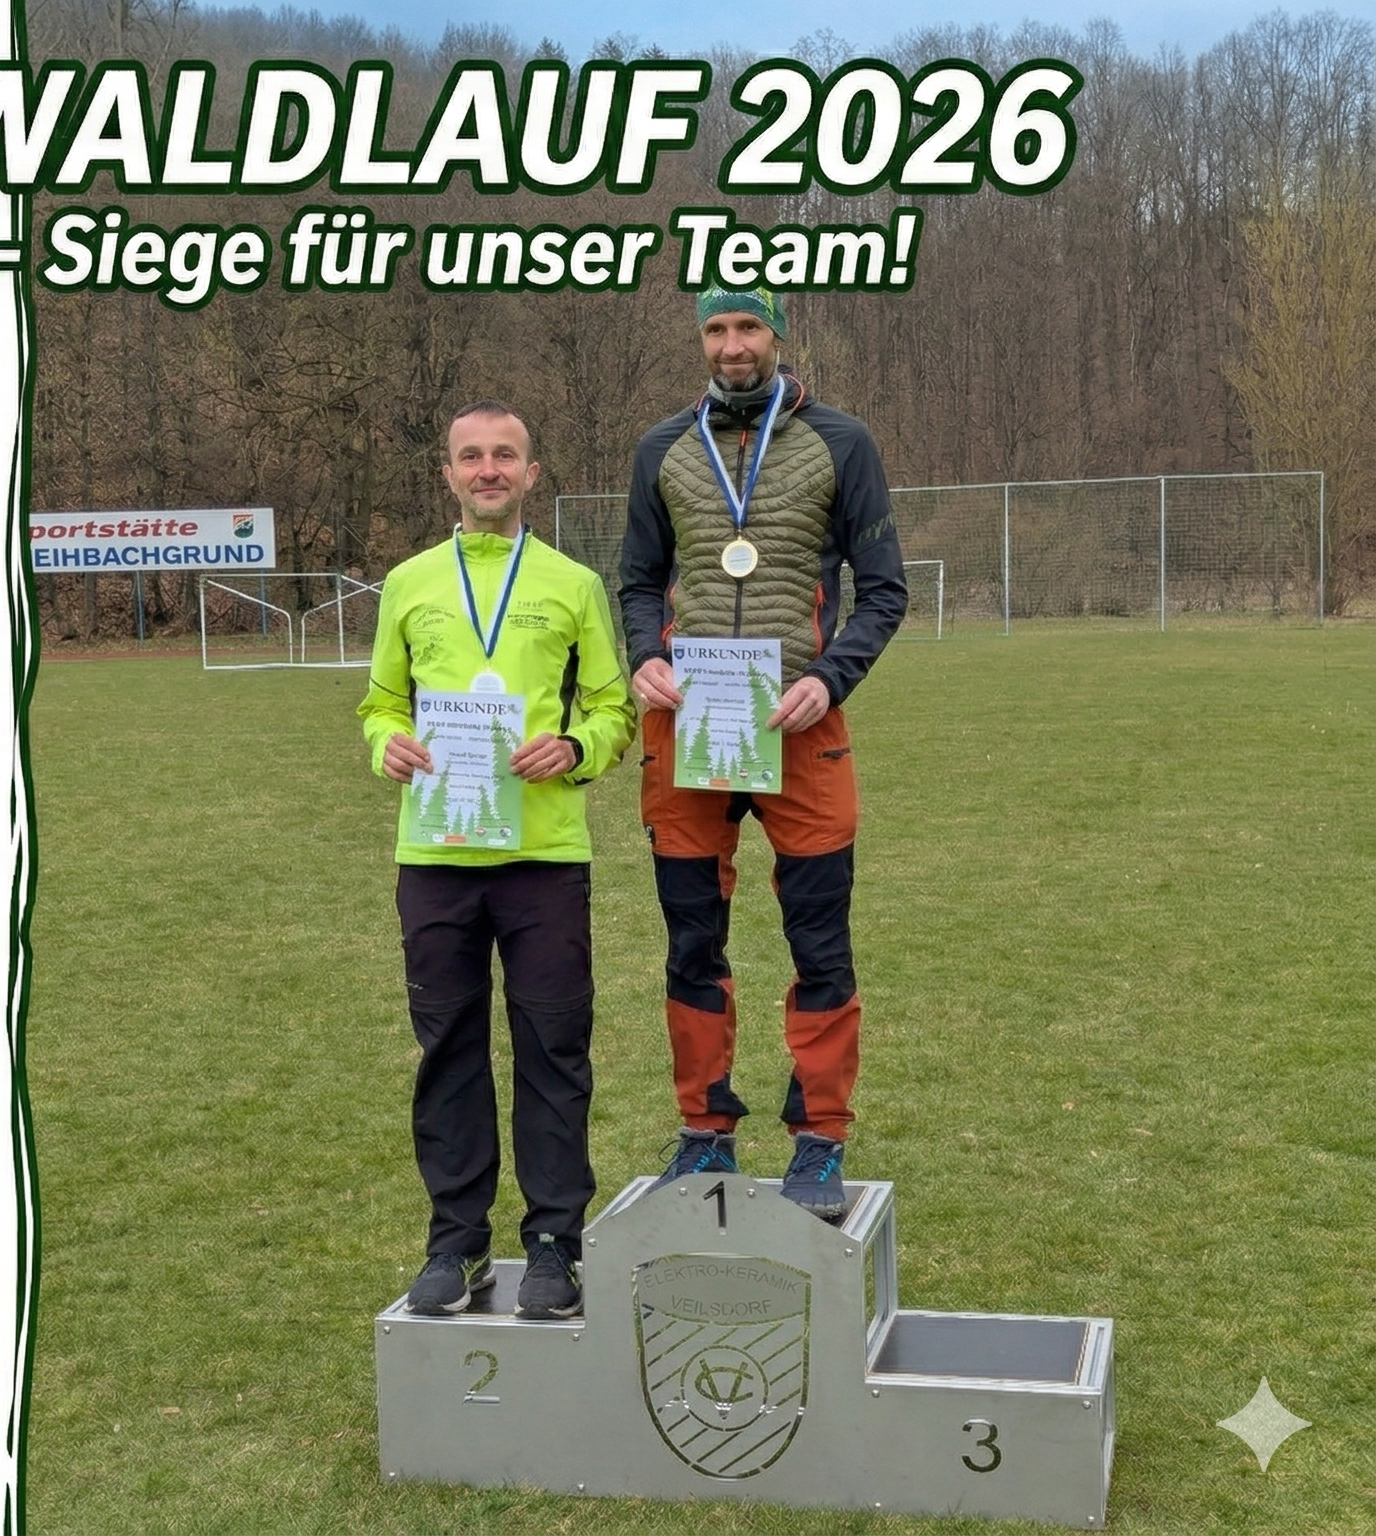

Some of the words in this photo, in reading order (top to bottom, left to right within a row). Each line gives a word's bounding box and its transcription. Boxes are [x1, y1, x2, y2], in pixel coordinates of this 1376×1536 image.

[34, 544, 265, 568] EIHBACHGRUND
[687, 647, 763, 661] URKUNDE
[433, 700, 508, 716] URKUNDE
[702, 1180, 727, 1236] 1
[643, 1263, 802, 1294] ELEKTRO-KERAMIK
[670, 1294, 773, 1318] VEILSDORF
[462, 1349, 501, 1405] 2
[961, 1418, 1002, 1474] 3
